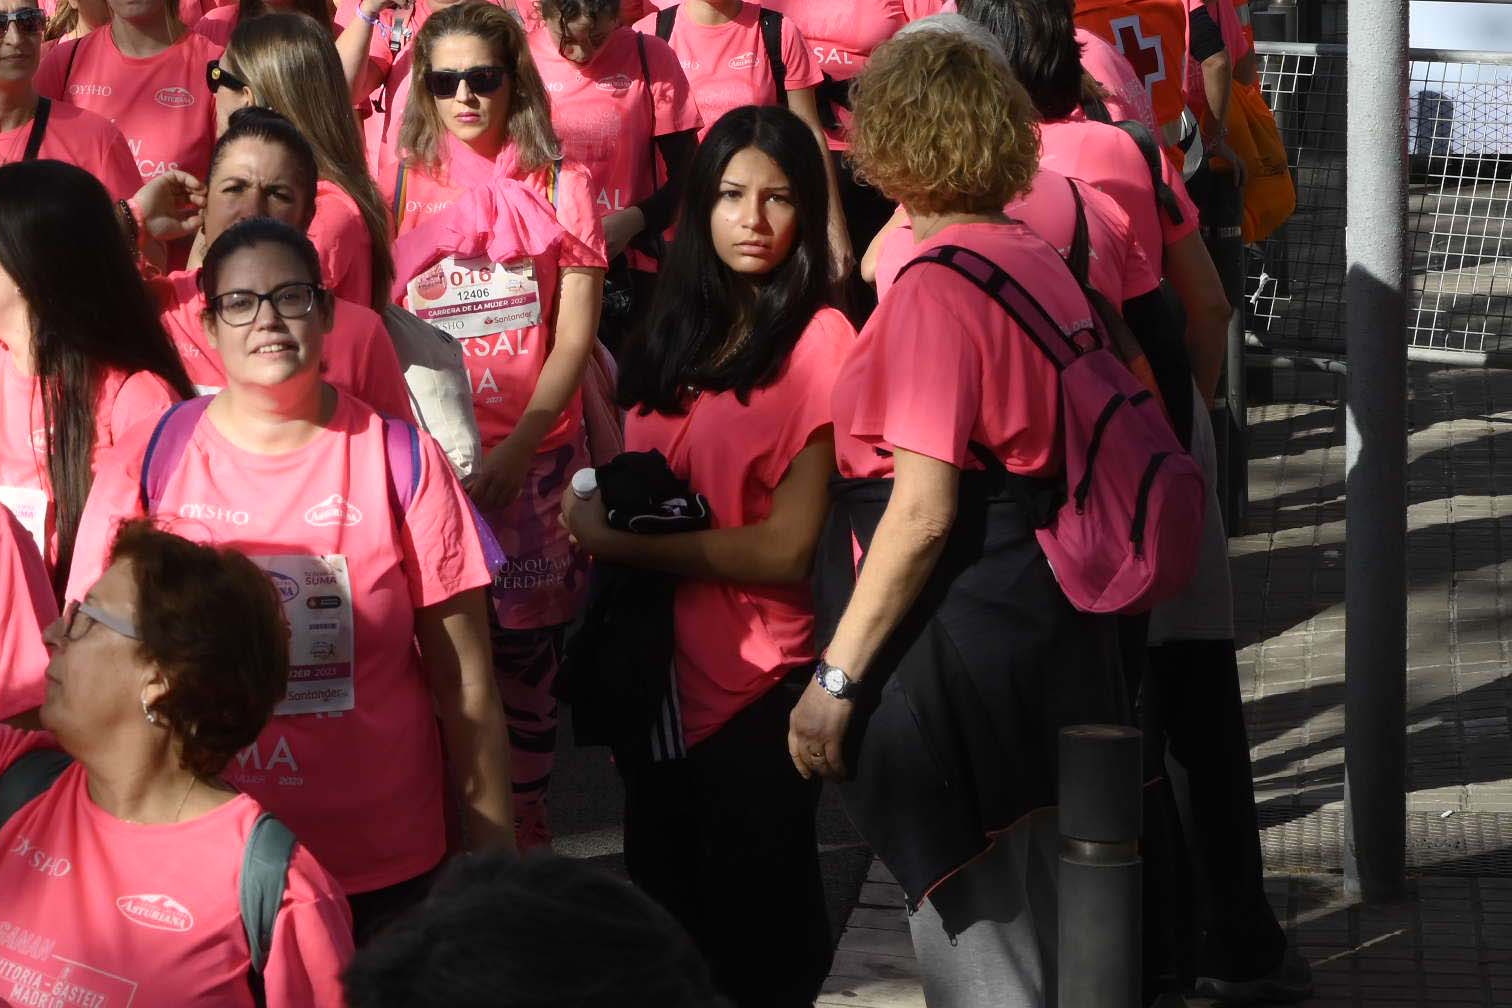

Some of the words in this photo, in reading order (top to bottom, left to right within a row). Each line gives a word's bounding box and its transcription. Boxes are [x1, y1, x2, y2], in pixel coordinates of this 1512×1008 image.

[450, 267, 493, 287] 016
[457, 287, 490, 302] 12406
[428, 305, 461, 317] CARRERA
[462, 304, 473, 313] DE
[473, 303, 484, 311] LA
[484, 299, 509, 310] MUJER
[494, 310, 534, 325] Santander
[180, 504, 249, 526] OYSHO
[304, 576, 338, 587] SUMA
[314, 667, 337, 677] 2023
[122, 900, 186, 930] ASTURIANA
[54, 979, 105, 1008] GASTEIZ
